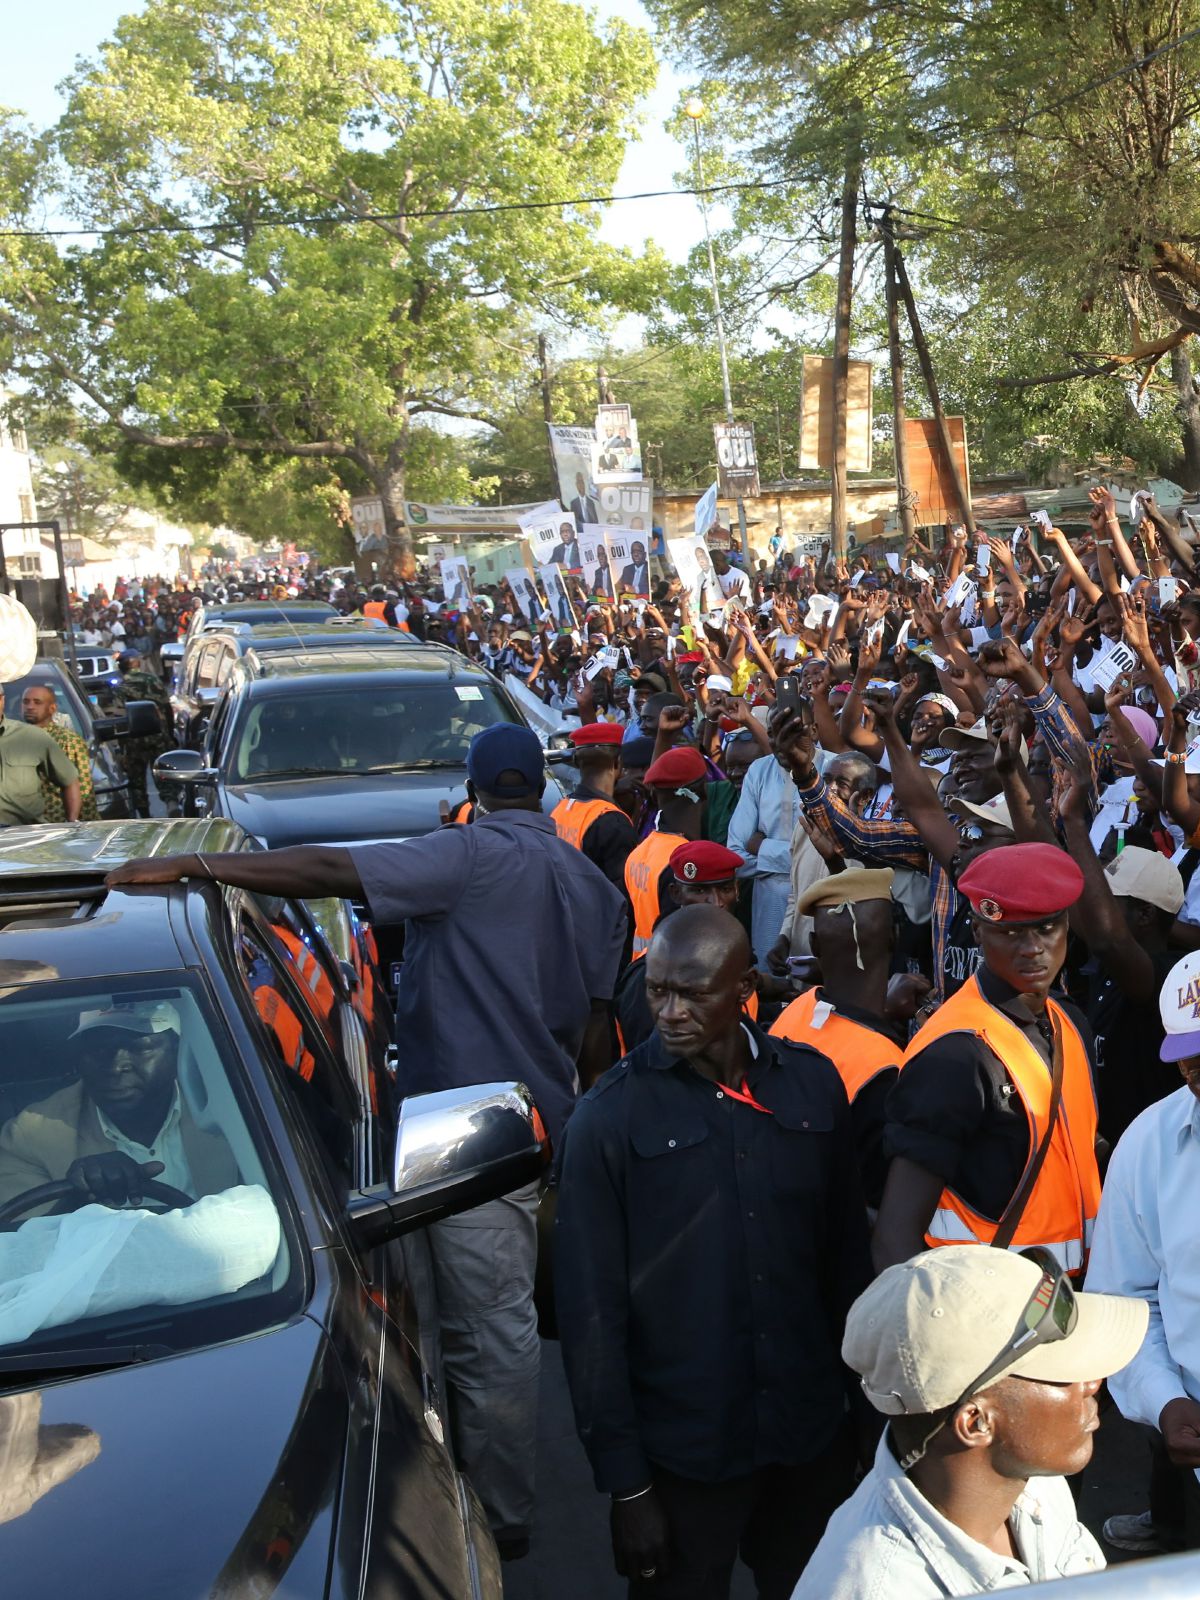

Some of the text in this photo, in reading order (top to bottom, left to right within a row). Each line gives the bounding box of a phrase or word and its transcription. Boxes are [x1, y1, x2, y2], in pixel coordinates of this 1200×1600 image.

[718, 437, 755, 468] OUI
[601, 486, 650, 513] OUI
[353, 505, 381, 523] OUI
[540, 528, 554, 541] OUI
[611, 545, 625, 558] OUI
[803, 543, 823, 551] COIF
[584, 549, 595, 562] OUI
[1110, 646, 1134, 672] OUI
